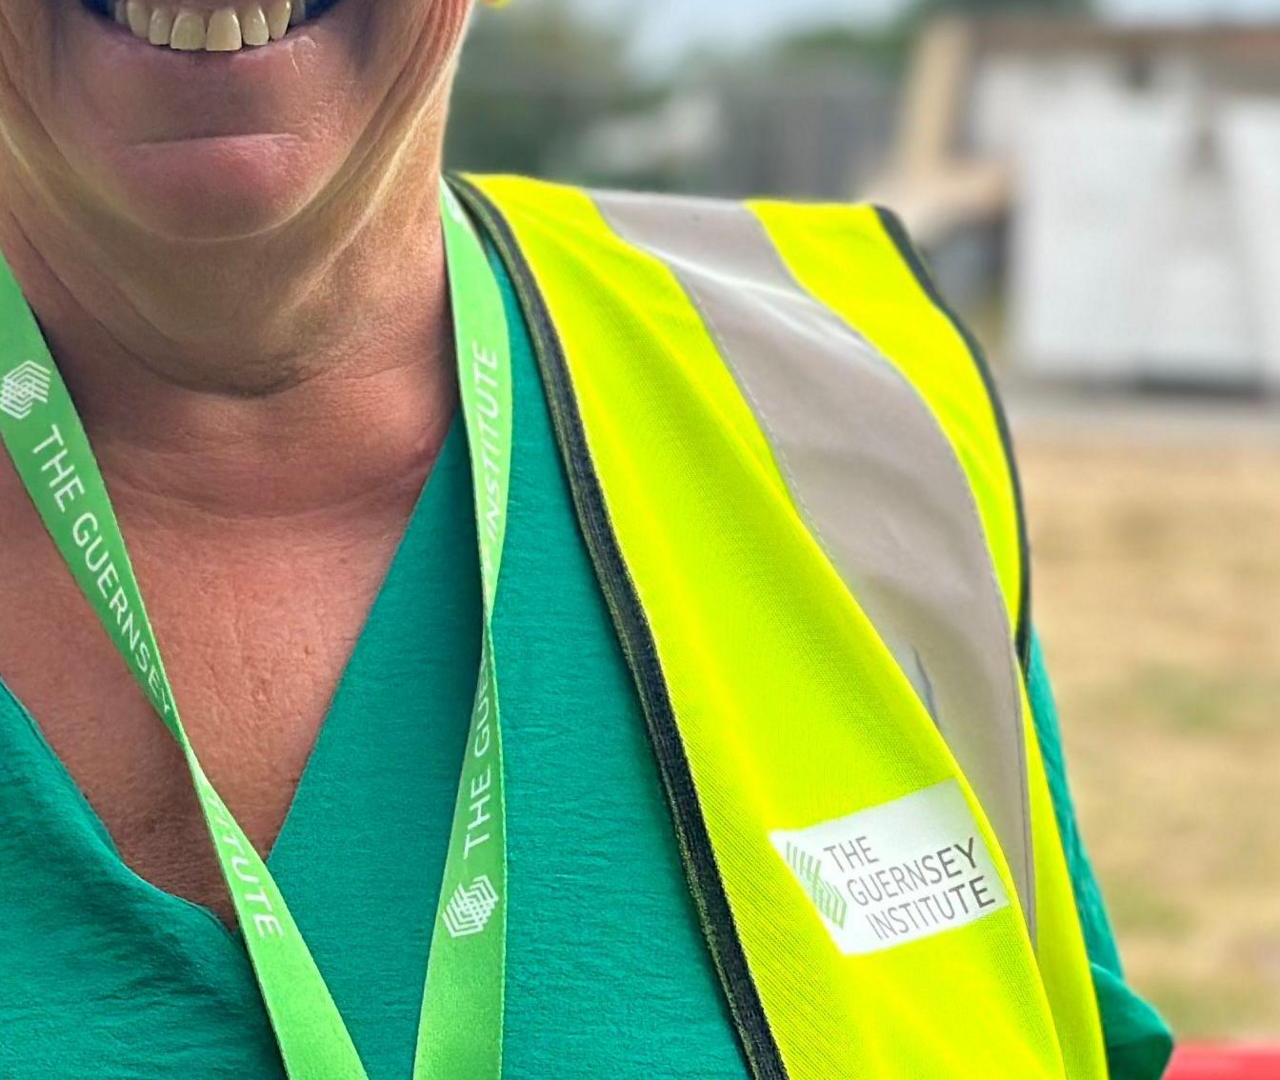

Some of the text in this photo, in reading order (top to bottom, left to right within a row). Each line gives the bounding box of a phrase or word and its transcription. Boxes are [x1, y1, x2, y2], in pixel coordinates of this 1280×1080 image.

[472, 341, 502, 542] INSTITUTE
[32, 423, 86, 513] THE
[72, 512, 171, 714] GUERNSEY
[463, 763, 492, 860] THE
[823, 835, 880, 874] THE
[846, 836, 980, 907] GUERNSEY
[864, 875, 996, 941] INSTITUTE
